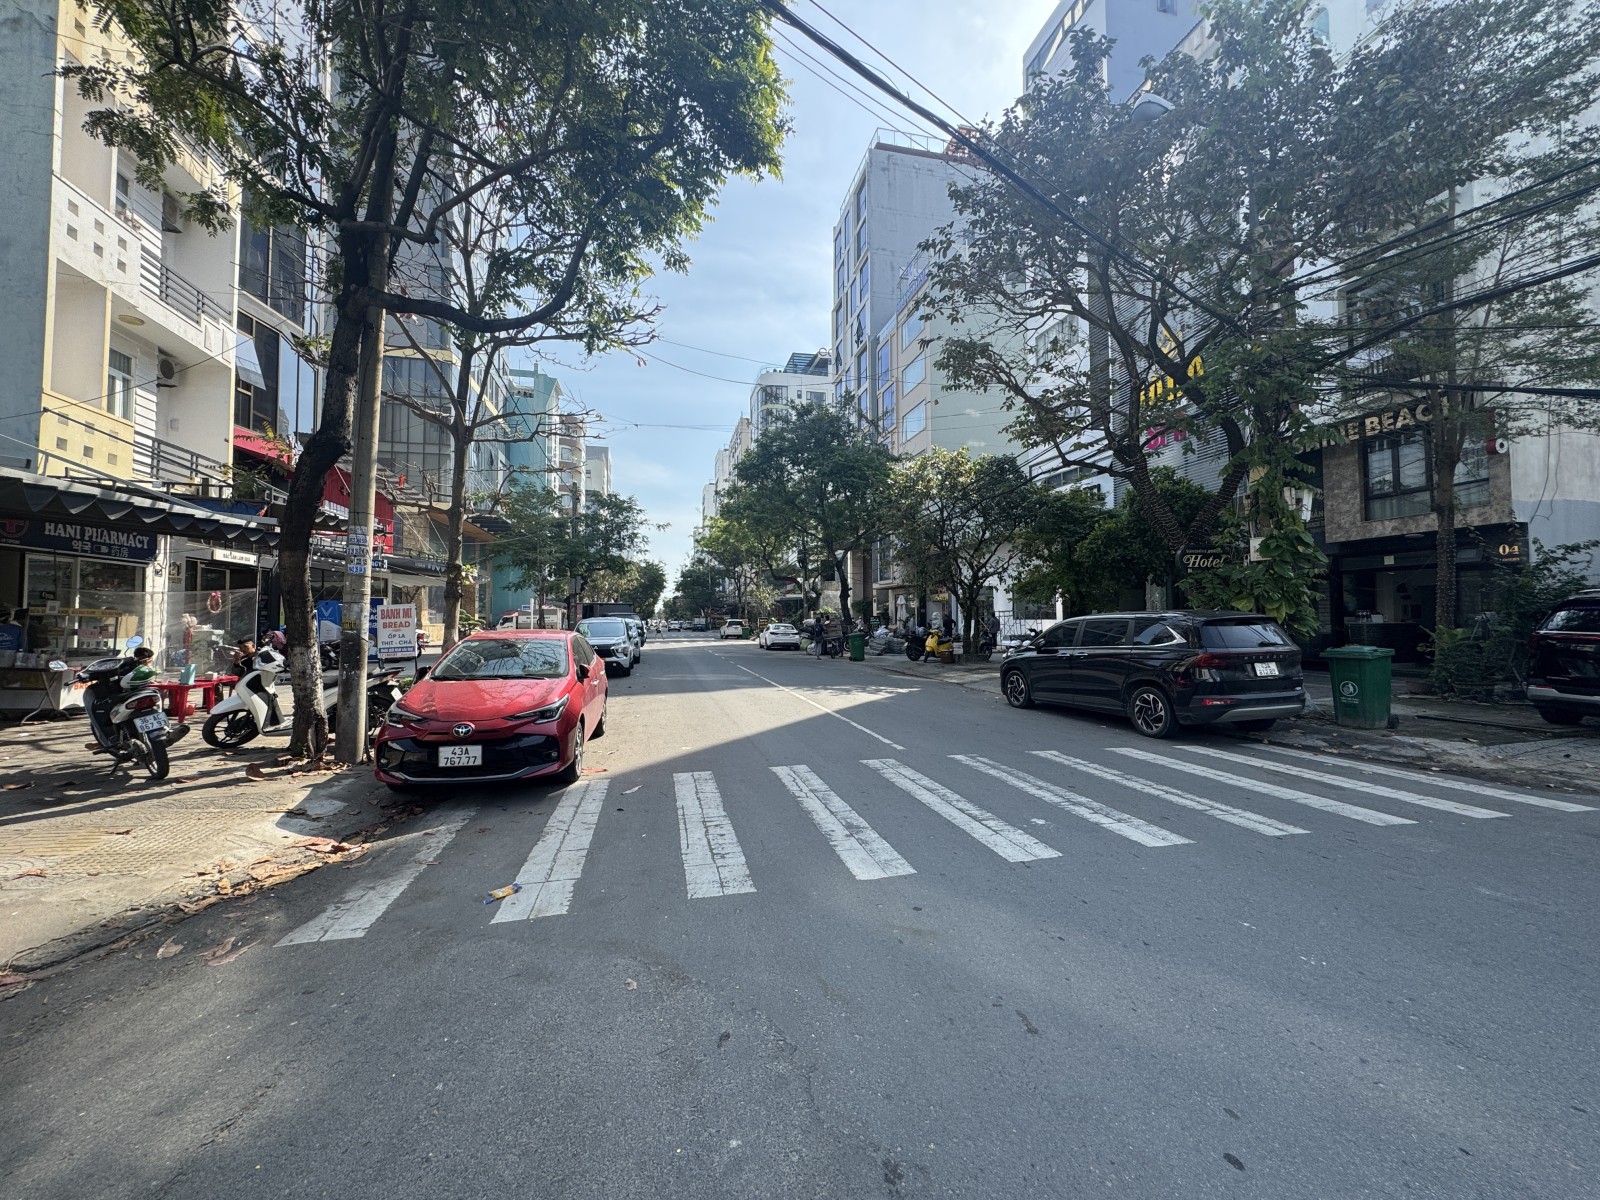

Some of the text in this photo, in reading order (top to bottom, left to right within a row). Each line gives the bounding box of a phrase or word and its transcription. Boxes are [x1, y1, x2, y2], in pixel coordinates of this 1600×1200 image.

[44, 521, 149, 549] HANI PHARMACY
[72, 540, 92, 554] 약국
[111, 545, 129, 558] 药房
[1499, 544, 1519, 555] 04
[1183, 554, 1229, 568] Hotel
[382, 621, 411, 629] BREAD
[451, 747, 470, 756] 43A
[443, 755, 478, 766] 767.77
